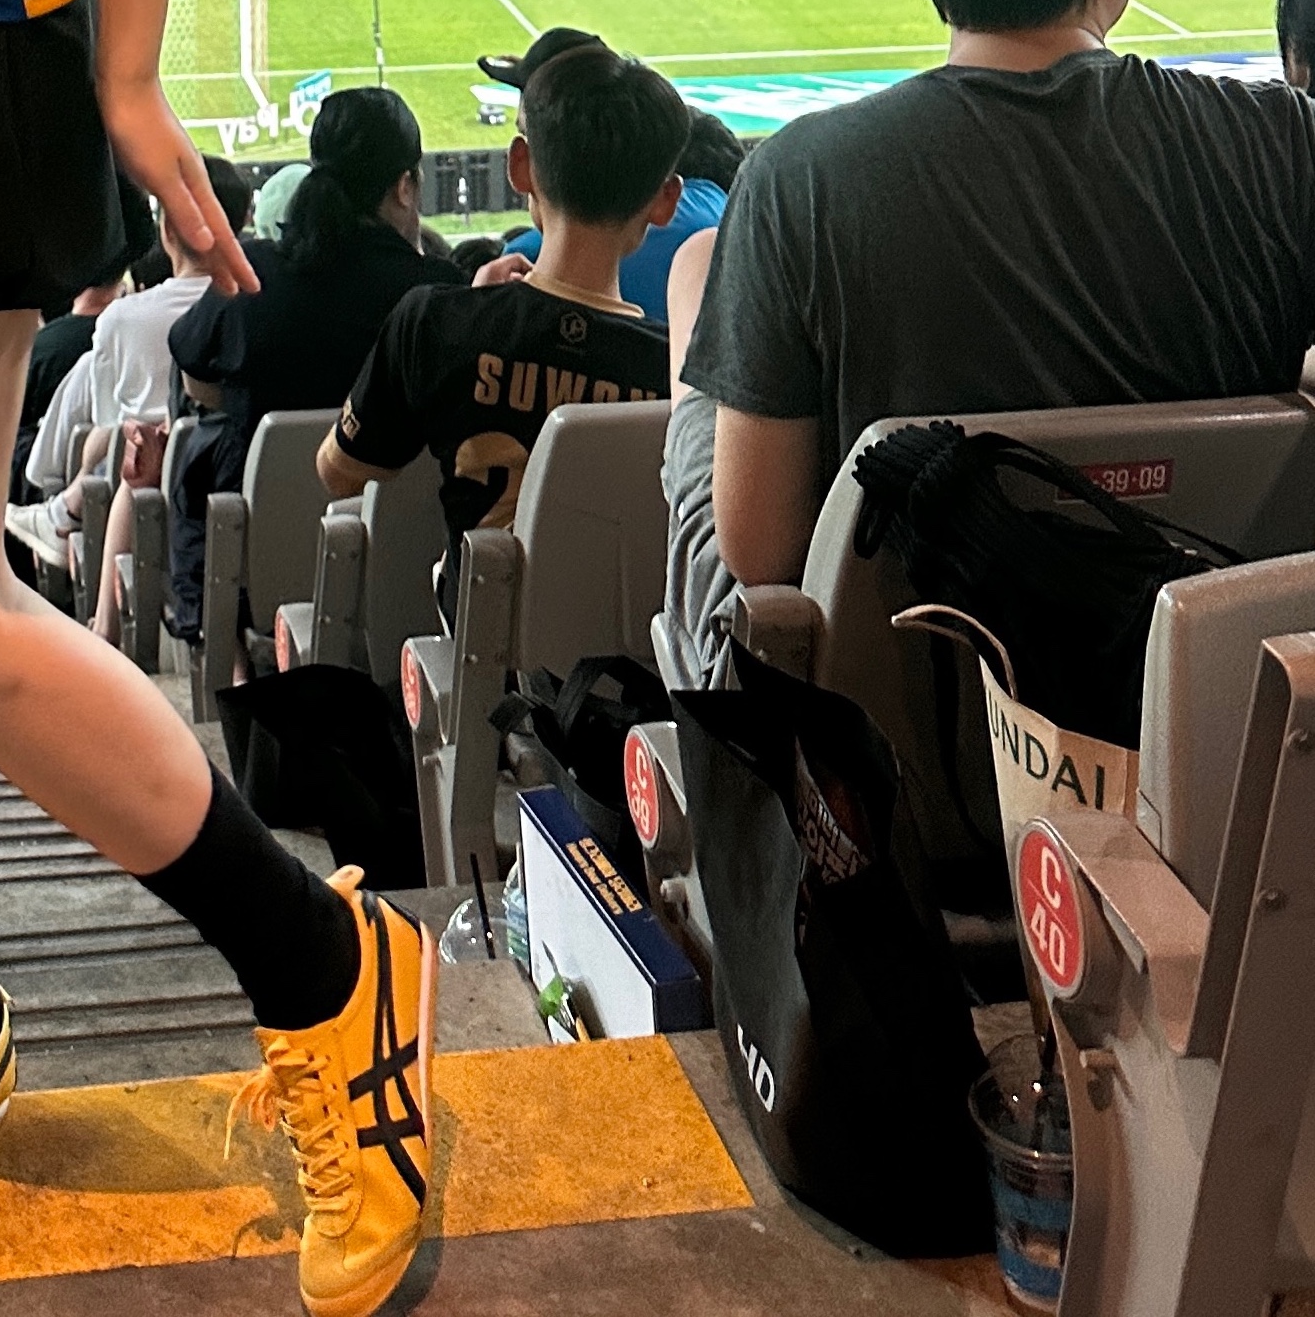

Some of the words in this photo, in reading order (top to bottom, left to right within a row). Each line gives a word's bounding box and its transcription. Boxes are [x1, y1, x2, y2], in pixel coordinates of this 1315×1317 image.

[473, 352, 657, 413] SUW
[635, 746, 647, 789] C
[1040, 846, 1062, 909] C
[1030, 904, 1066, 977] 40
